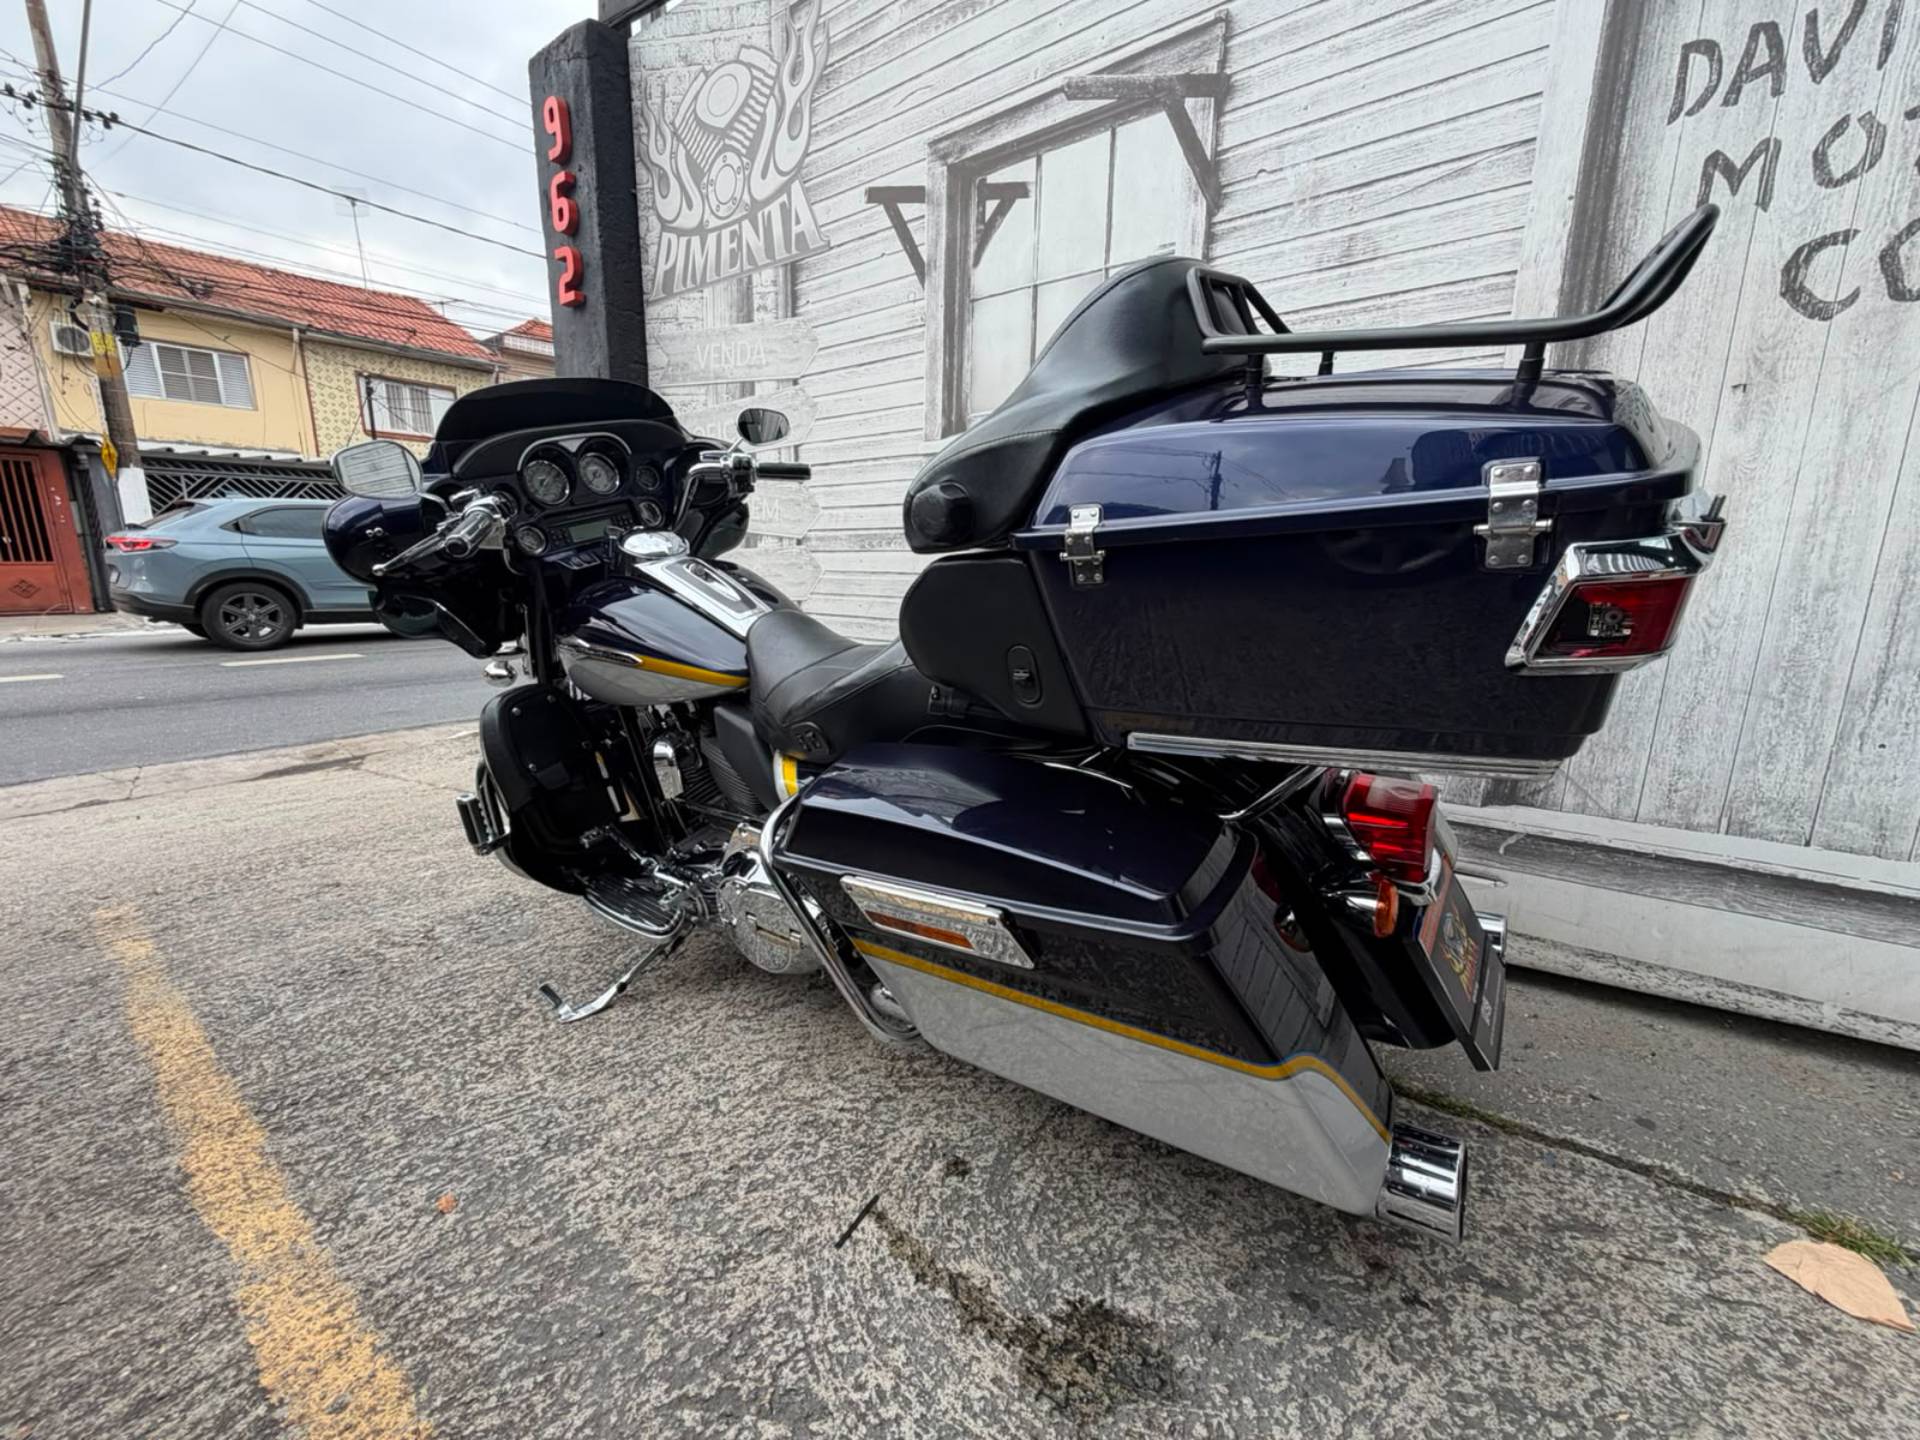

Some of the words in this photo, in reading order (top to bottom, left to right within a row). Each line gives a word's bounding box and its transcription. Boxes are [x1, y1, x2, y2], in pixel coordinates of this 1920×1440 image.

[543, 95, 585, 308] 962
[652, 179, 828, 301] PIMENTA
[697, 339, 768, 369] VENDA
